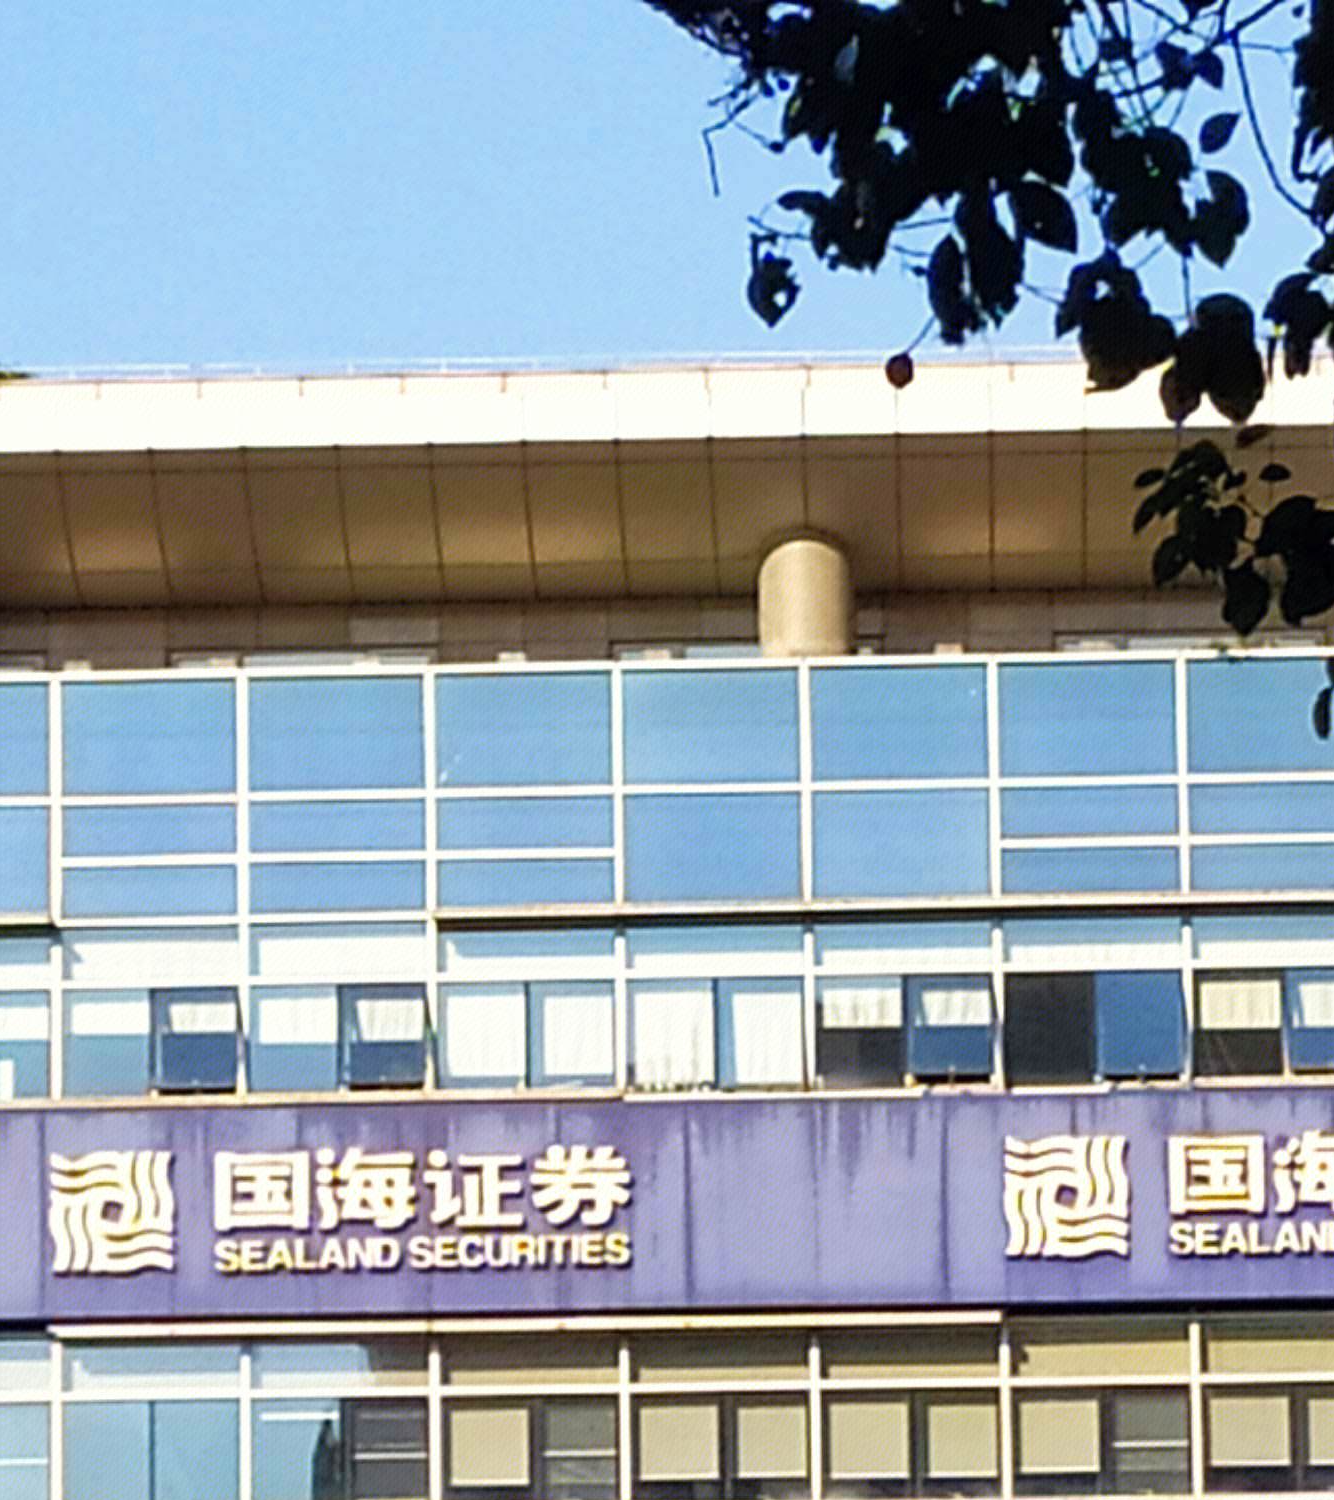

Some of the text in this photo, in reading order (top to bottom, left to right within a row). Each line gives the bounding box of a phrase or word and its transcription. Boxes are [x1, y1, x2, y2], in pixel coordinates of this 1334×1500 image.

[213, 1144, 632, 1231] 国海证券
[213, 1232, 632, 1273] SEALAND SECURITIES
